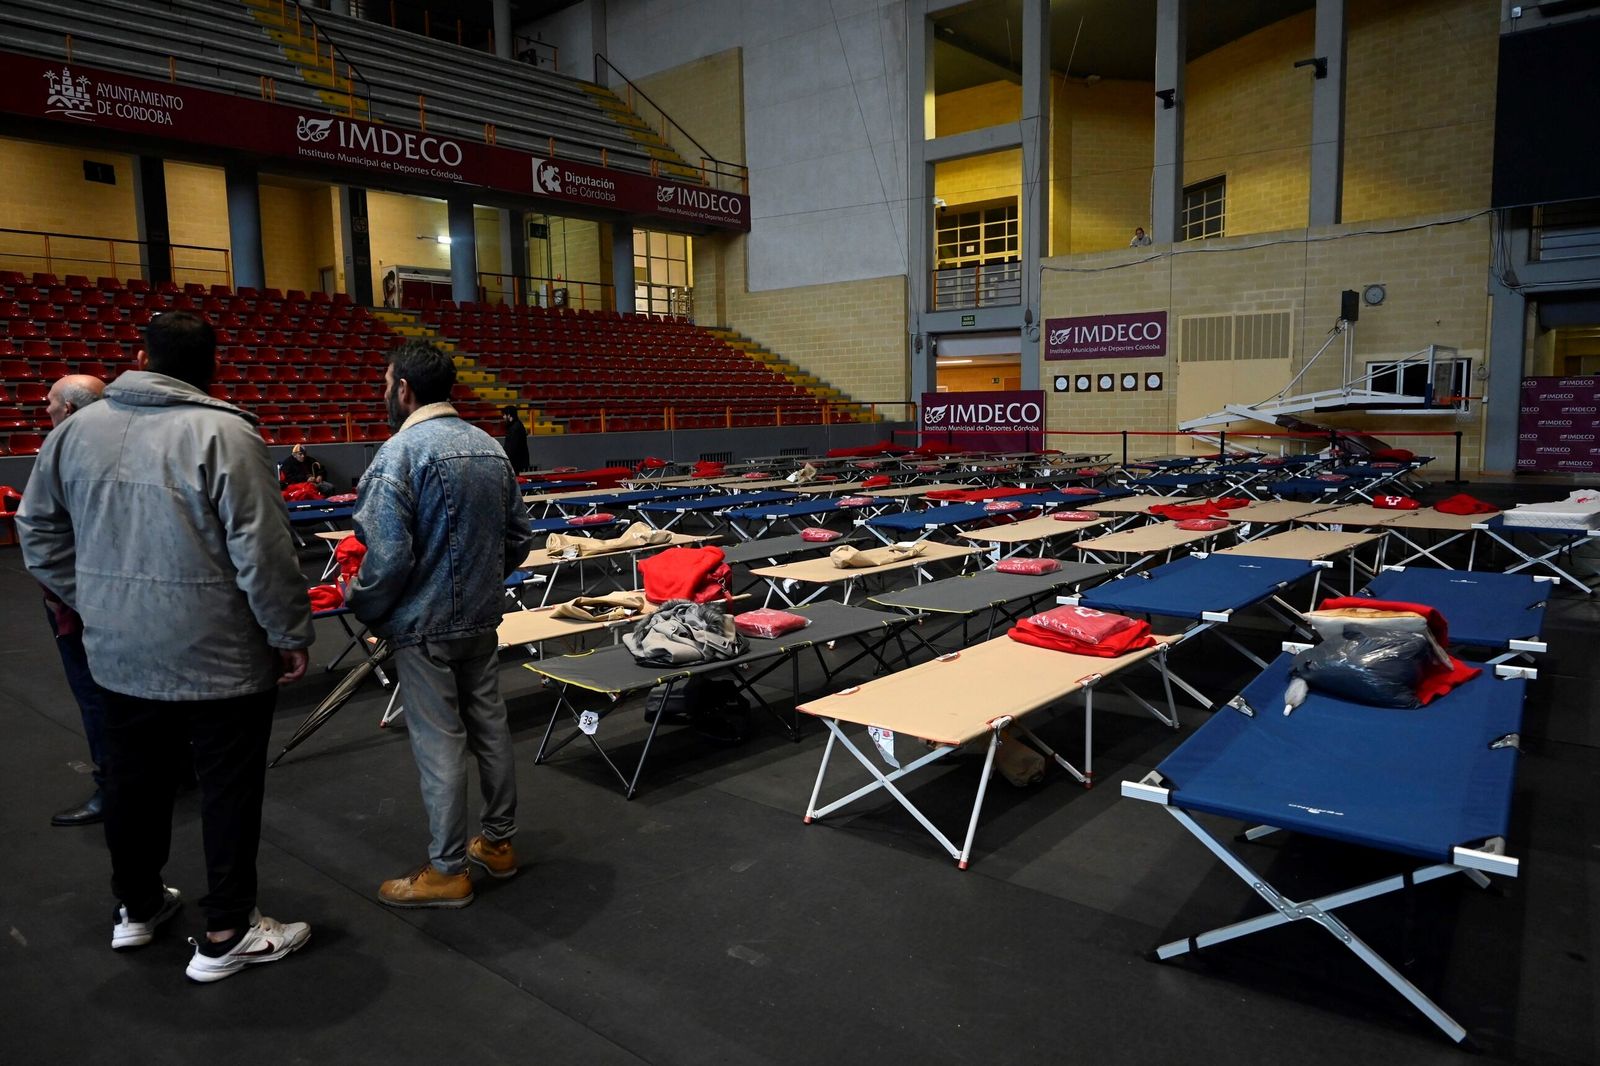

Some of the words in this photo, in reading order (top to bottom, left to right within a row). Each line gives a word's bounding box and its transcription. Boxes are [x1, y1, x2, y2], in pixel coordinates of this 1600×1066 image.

[96, 82, 184, 110] AYUNTAMIENTO
[97, 100, 113, 116] DE
[116, 102, 173, 126] CÓRDOBA
[338, 120, 463, 167] IMDECO
[298, 146, 335, 160] Instituto
[337, 152, 379, 167] Municipal
[381, 161, 392, 170] de
[393, 162, 429, 176] Deportes
[431, 168, 463, 181] Córdoba
[565, 171, 615, 190] Diputación
[566, 186, 577, 196] de
[579, 187, 616, 202] Córdoba
[678, 187, 742, 215] IMDECO
[657, 205, 676, 214] Instituto
[676, 208, 697, 218] Municipal
[705, 213, 723, 222] Deportes
[724, 216, 742, 224] Córdoba
[1074, 321, 1161, 344] IMDECO
[950, 402, 1041, 424] IMDECO
[1013, 424, 1039, 432] Córdoba
